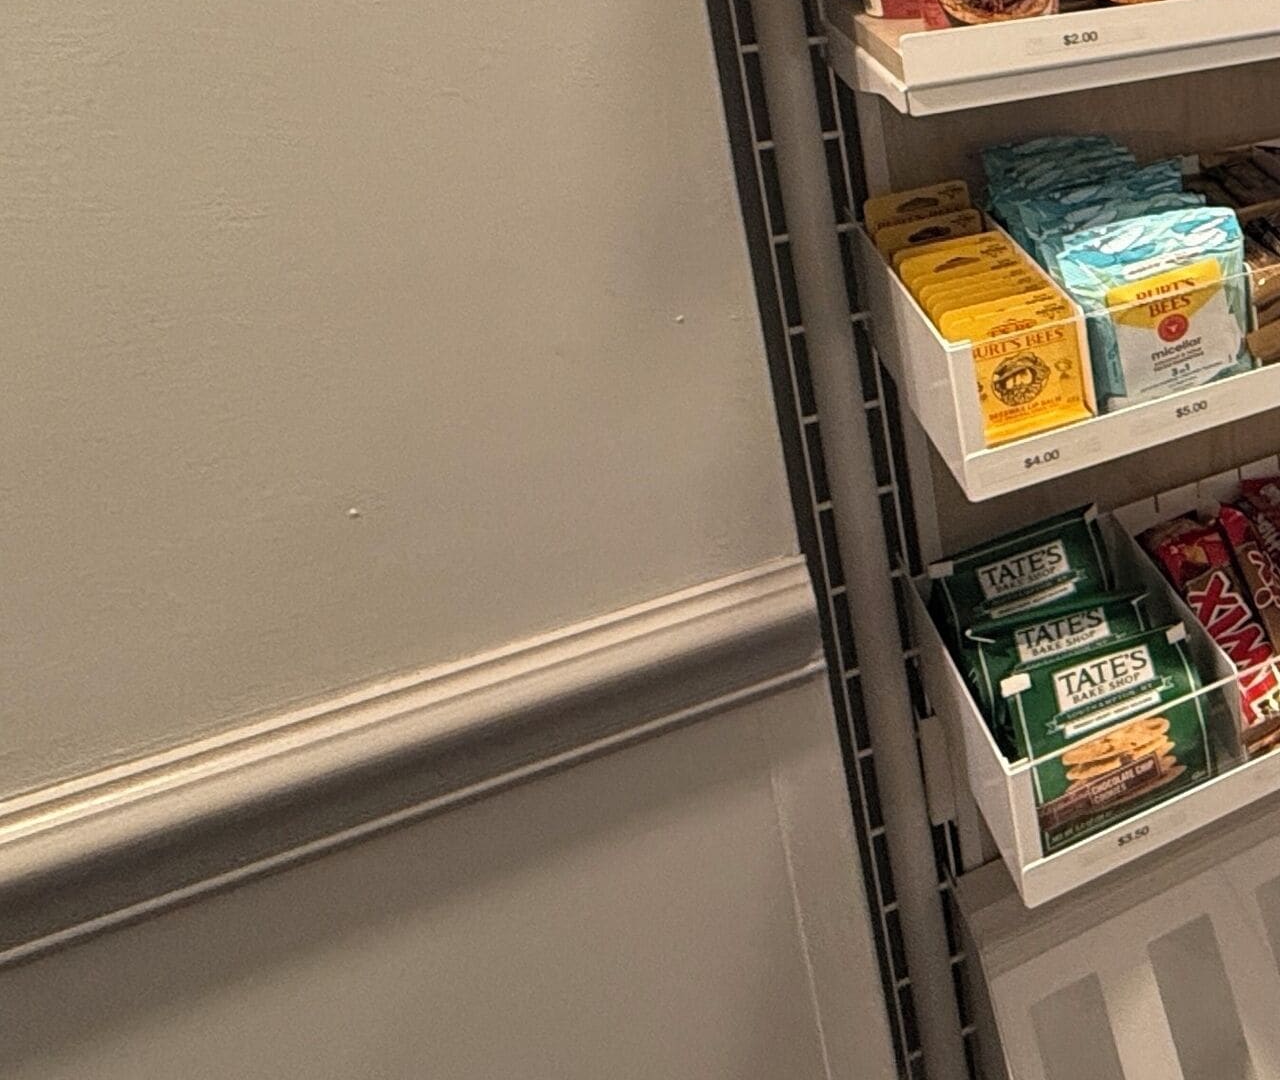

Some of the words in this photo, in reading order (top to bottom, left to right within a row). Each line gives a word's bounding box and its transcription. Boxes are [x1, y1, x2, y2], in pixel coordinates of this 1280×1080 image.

[1063, 31, 1098, 47] $2.00
[1148, 294, 1191, 318] BEES
[1025, 327, 1064, 347] BEES
[1151, 336, 1202, 362] micellar
[1175, 400, 1208, 419] $5.00
[1024, 448, 1060, 469] $4.00
[982, 545, 1062, 587] TATE'S
[1018, 610, 1103, 649] TATE'S
[1032, 640, 1061, 656] BAKE
[1065, 630, 1096, 646] SHOP
[1187, 571, 1277, 727] TWIX
[1058, 650, 1148, 696] TATE'S
[1072, 684, 1104, 704] BAKE
[1109, 671, 1141, 689] SHOP
[1118, 826, 1150, 847] $3.50
